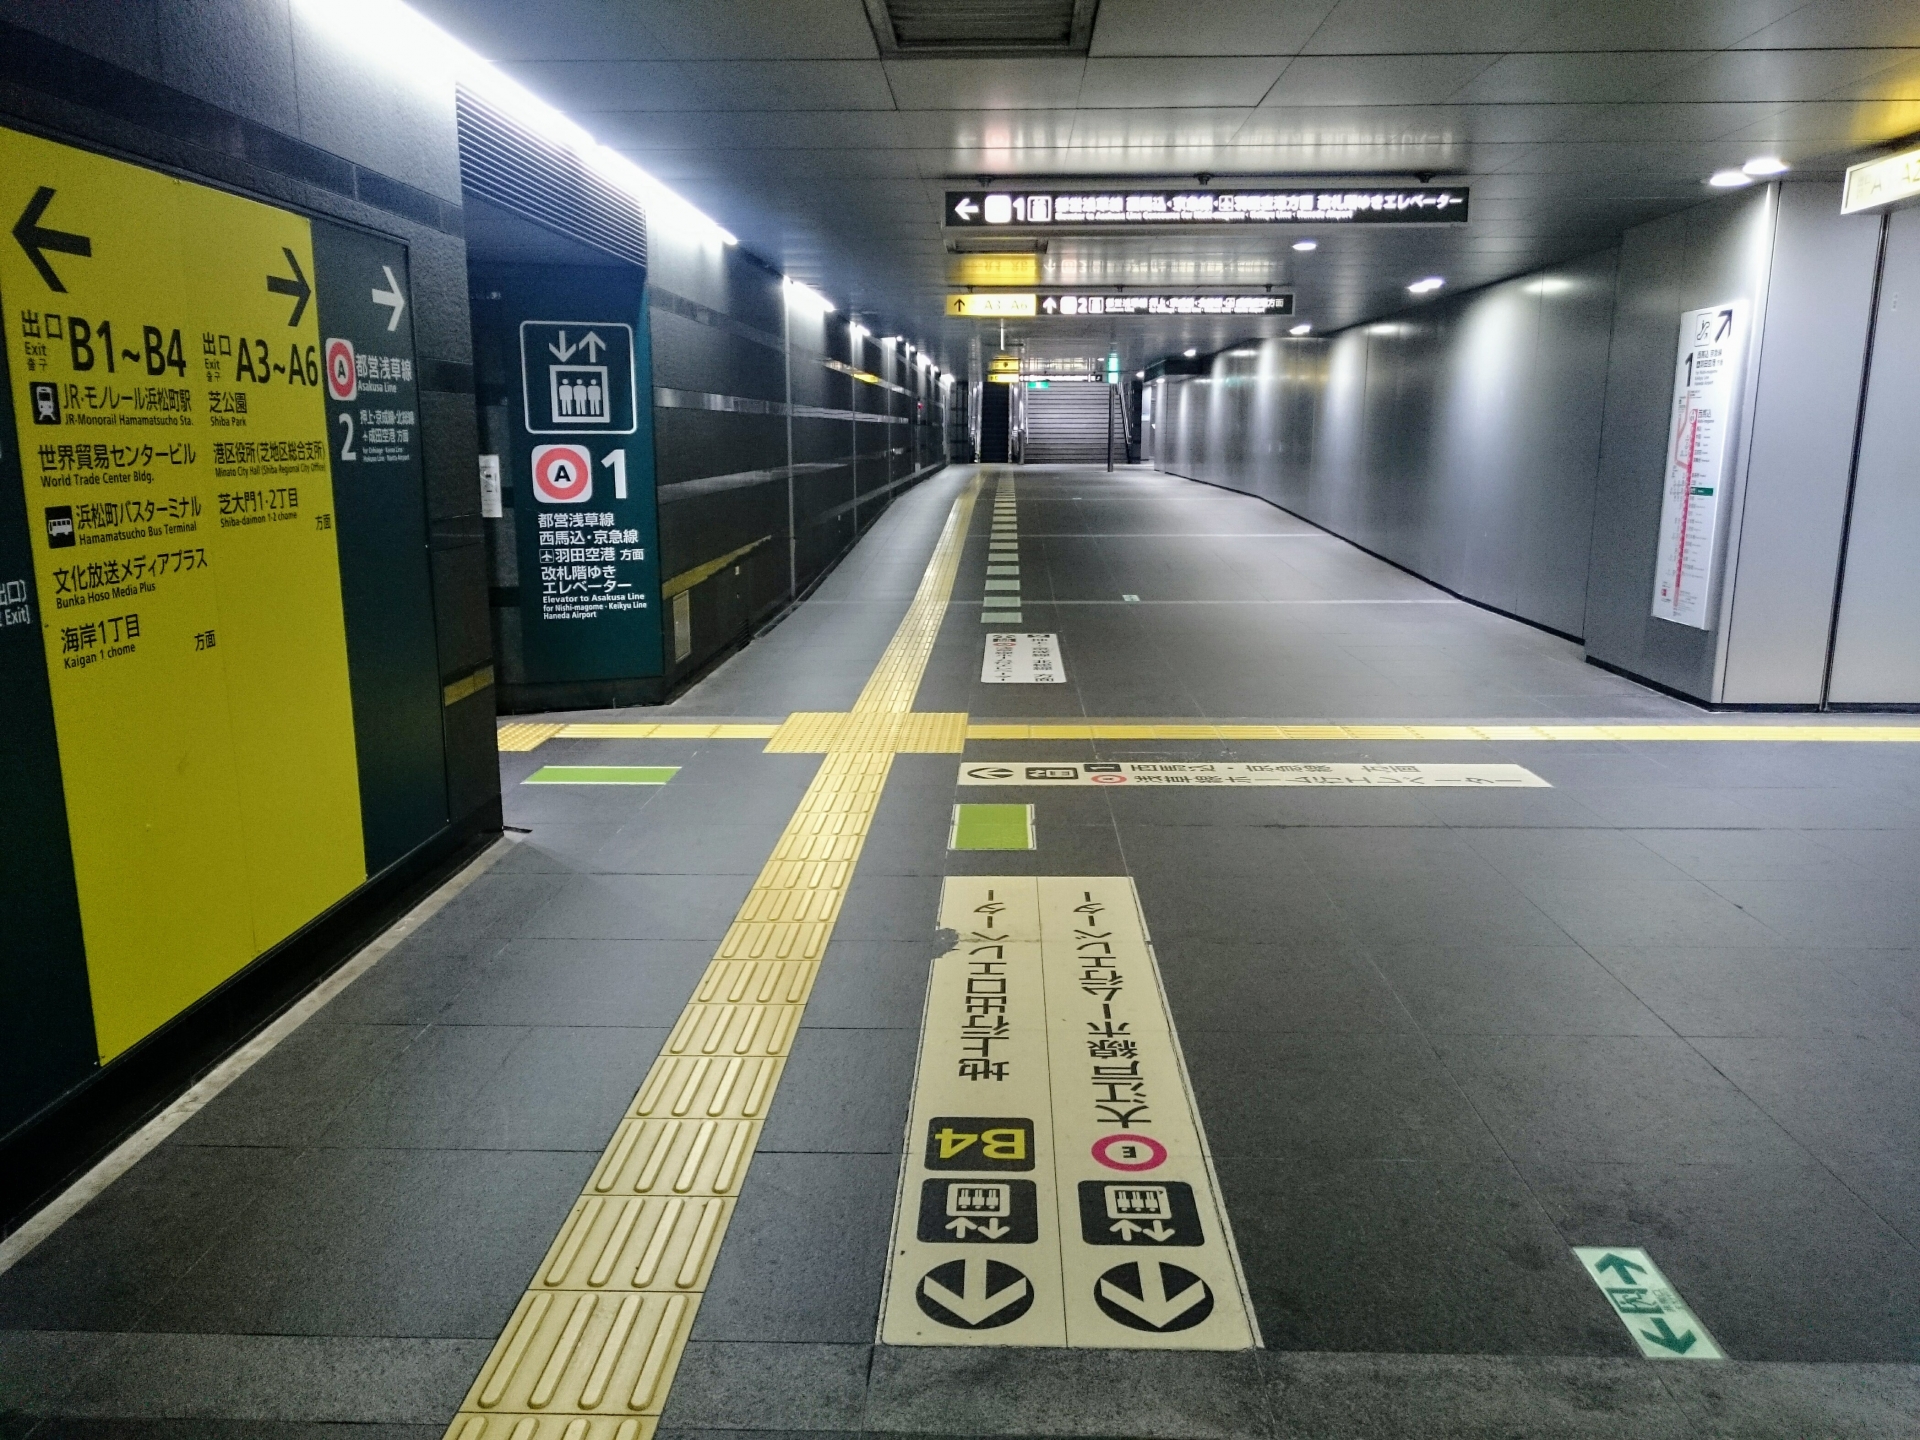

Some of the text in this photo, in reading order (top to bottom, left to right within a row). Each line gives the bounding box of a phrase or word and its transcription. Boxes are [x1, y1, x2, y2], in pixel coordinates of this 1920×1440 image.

[1013, 197, 1025, 221] 1
[1078, 297, 1088, 314] 2
[21, 309, 187, 377] 出口 B1~B4
[25, 342, 47, 356] Exit
[202, 332, 318, 387] 出口 A3~A6
[205, 359, 220, 370] Exit
[337, 359, 347, 379] A
[356, 353, 413, 381] 都営浅草線
[1685, 352, 1694, 387] 1
[357, 380, 397, 393] Asakusa Line
[208, 391, 247, 414] 芝公園
[120, 414, 178, 425] Hamamatsucho
[180, 415, 194, 425] Sta.
[211, 416, 247, 426] Shiba Park
[339, 412, 356, 461] 2
[38, 443, 196, 472] 世界貿易センタービル
[40, 471, 155, 487] World Trade Center Bldg.
[215, 467, 237, 478] Minato
[237, 466, 249, 478] City
[250, 466, 260, 476] Hall
[300, 464, 310, 474] City
[553, 449, 627, 499] A 1
[76, 496, 202, 530] 浜松町バスターミナル
[220, 515, 266, 528] Shiba-daimon
[278, 511, 297, 521] chome
[315, 513, 332, 531] 方面
[538, 512, 615, 528] 都営浅草線
[79, 522, 197, 546] Hamamatsucho Bus Terminal
[538, 529, 639, 546] 西馬込・京急線
[554, 547, 645, 563] 羽田空港 方面
[52, 548, 208, 594] 文化放送メディアプラス
[541, 564, 616, 580] 改札階ゆき
[56, 582, 156, 609] Bunka Hoso Media Plus
[543, 579, 632, 594] エレベーター
[543, 595, 578, 604] Elevator
[591, 593, 626, 602] Asakusa
[627, 592, 645, 600] Line
[543, 604, 554, 612] for
[555, 603, 603, 612] Nishi-magome
[608, 602, 632, 611] Keikyu
[633, 601, 647, 609] Line
[543, 611, 597, 620] Haneda Airport
[61, 613, 140, 654] 海岸1丁目
[194, 629, 216, 652] 方面
[64, 643, 136, 670] Kaigan 1 chome
[935, 889, 1025, 1160] B4 地上行出口エレベーター
[1073, 891, 1152, 1159] E 大江戸線ホーム行エレベーター
